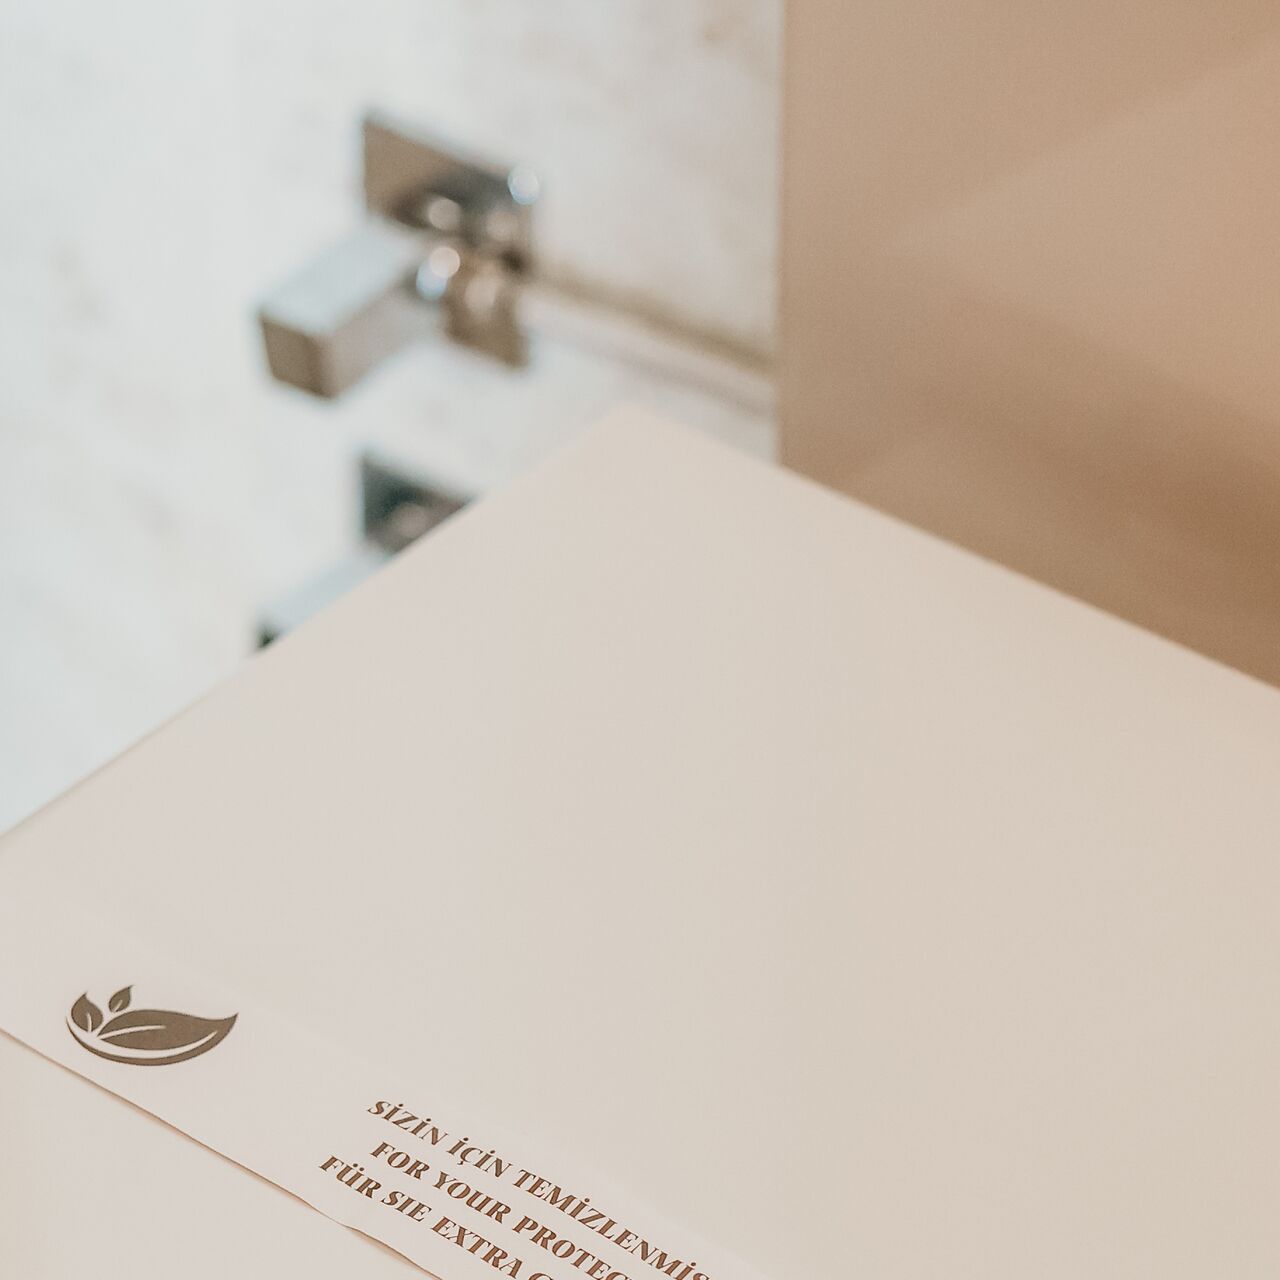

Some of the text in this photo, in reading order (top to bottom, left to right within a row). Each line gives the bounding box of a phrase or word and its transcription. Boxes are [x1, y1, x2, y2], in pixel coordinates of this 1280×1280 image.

[367, 1100, 449, 1146] SİZİN
[446, 1137, 513, 1178] İÇİN
[318, 1155, 382, 1199] FÜR
[381, 1190, 432, 1222] SIE
[430, 1216, 524, 1279] EXTRA
[370, 1141, 430, 1180] FOR
[432, 1171, 512, 1224] YOUR
